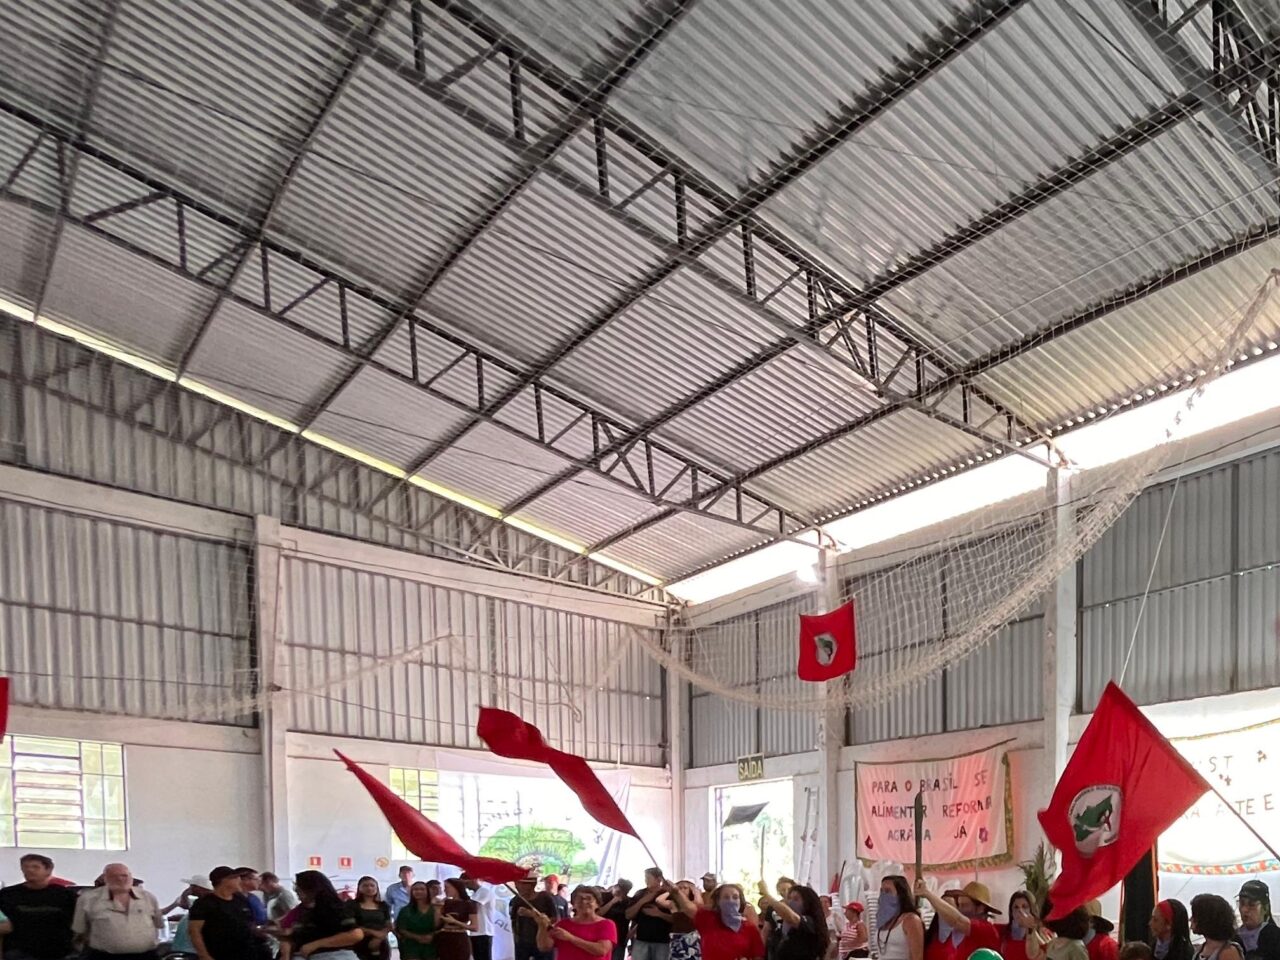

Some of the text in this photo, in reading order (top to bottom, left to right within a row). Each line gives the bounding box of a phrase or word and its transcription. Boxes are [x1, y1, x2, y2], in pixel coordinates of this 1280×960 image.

[872, 780, 898, 793] PARA
[905, 780, 913, 791] O
[974, 770, 988, 787] SE
[871, 796, 992, 818] ALIMENTR REFORMA
[953, 822, 968, 839] JÁ
